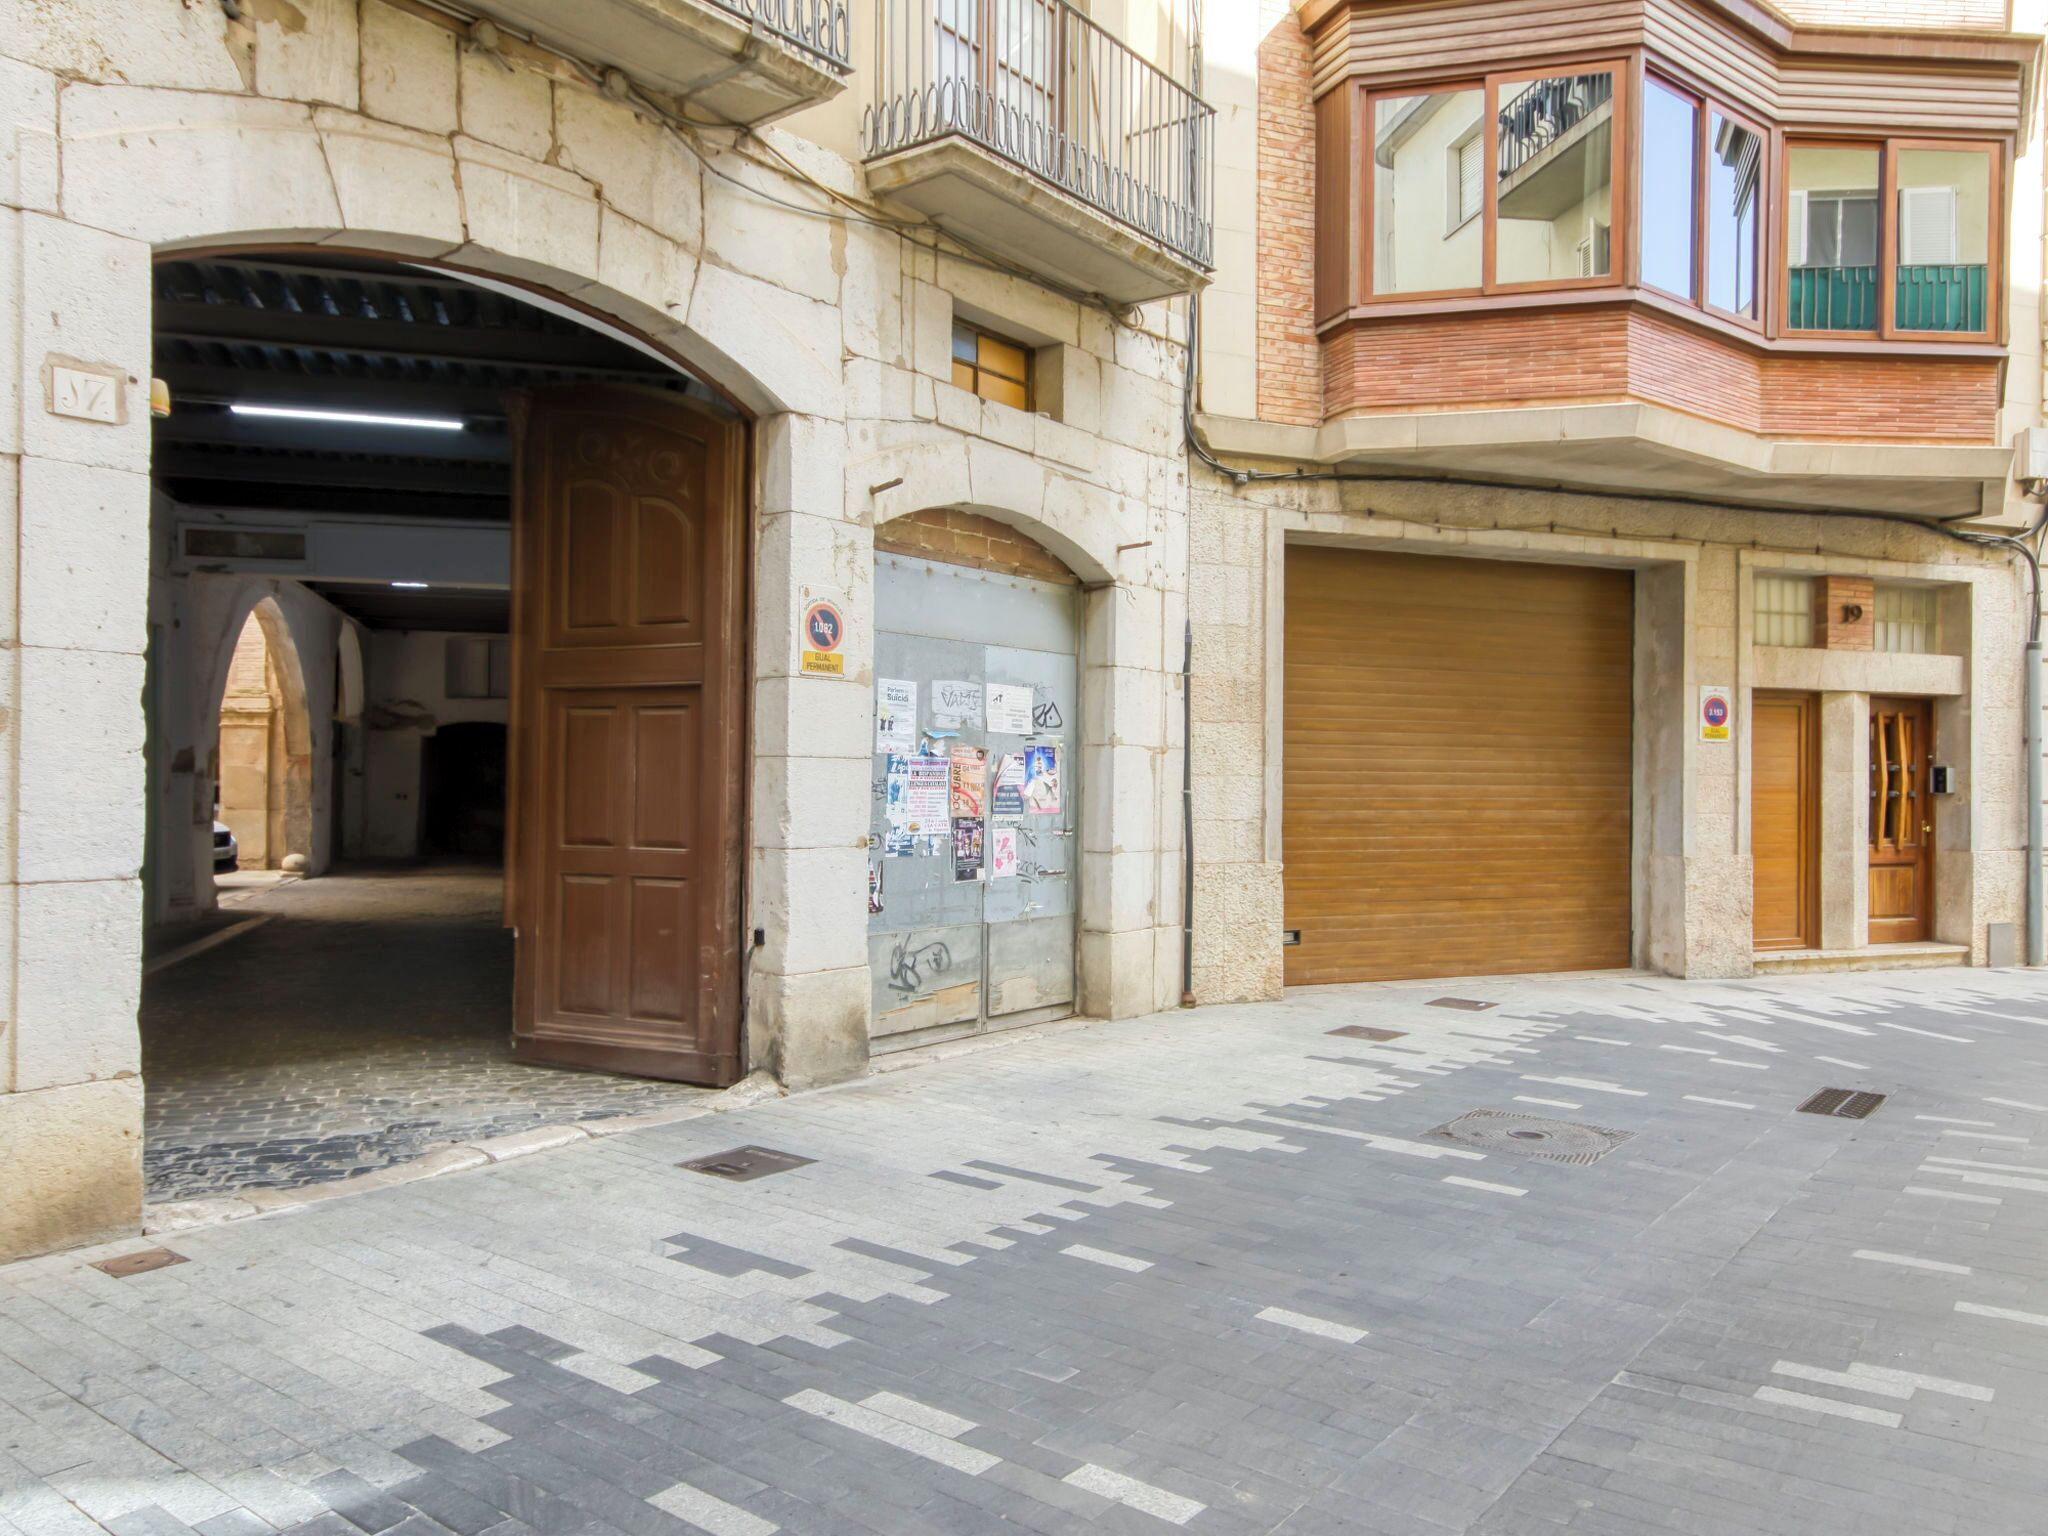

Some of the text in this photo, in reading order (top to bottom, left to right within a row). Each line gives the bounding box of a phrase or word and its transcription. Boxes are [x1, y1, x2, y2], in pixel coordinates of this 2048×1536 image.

[1841, 605, 1863, 624] 19
[815, 652, 831, 662] GUAL
[806, 661, 840, 673] PERMANENT
[953, 762, 961, 810] OCTUBRE
